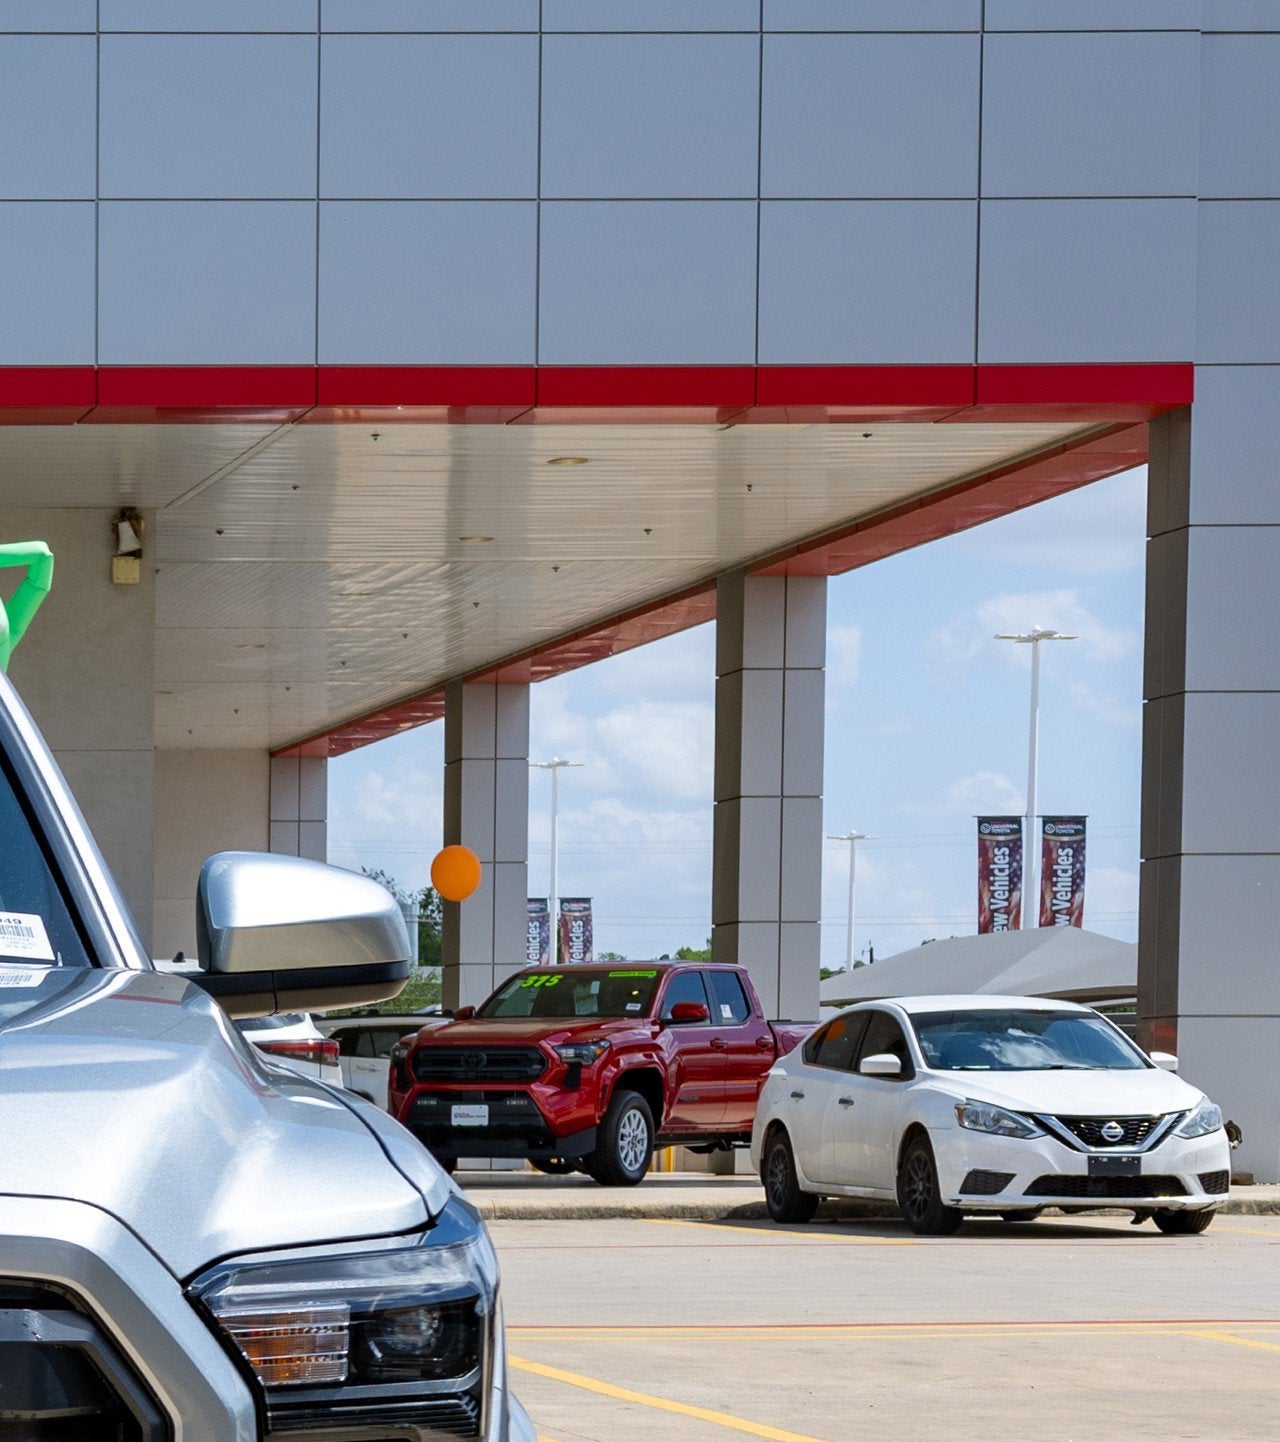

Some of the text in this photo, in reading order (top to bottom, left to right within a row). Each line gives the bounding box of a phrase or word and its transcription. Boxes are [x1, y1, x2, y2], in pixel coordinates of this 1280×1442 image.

[990, 847, 1009, 934] ew Vehicles
[1053, 848, 1073, 911] Vehicles
